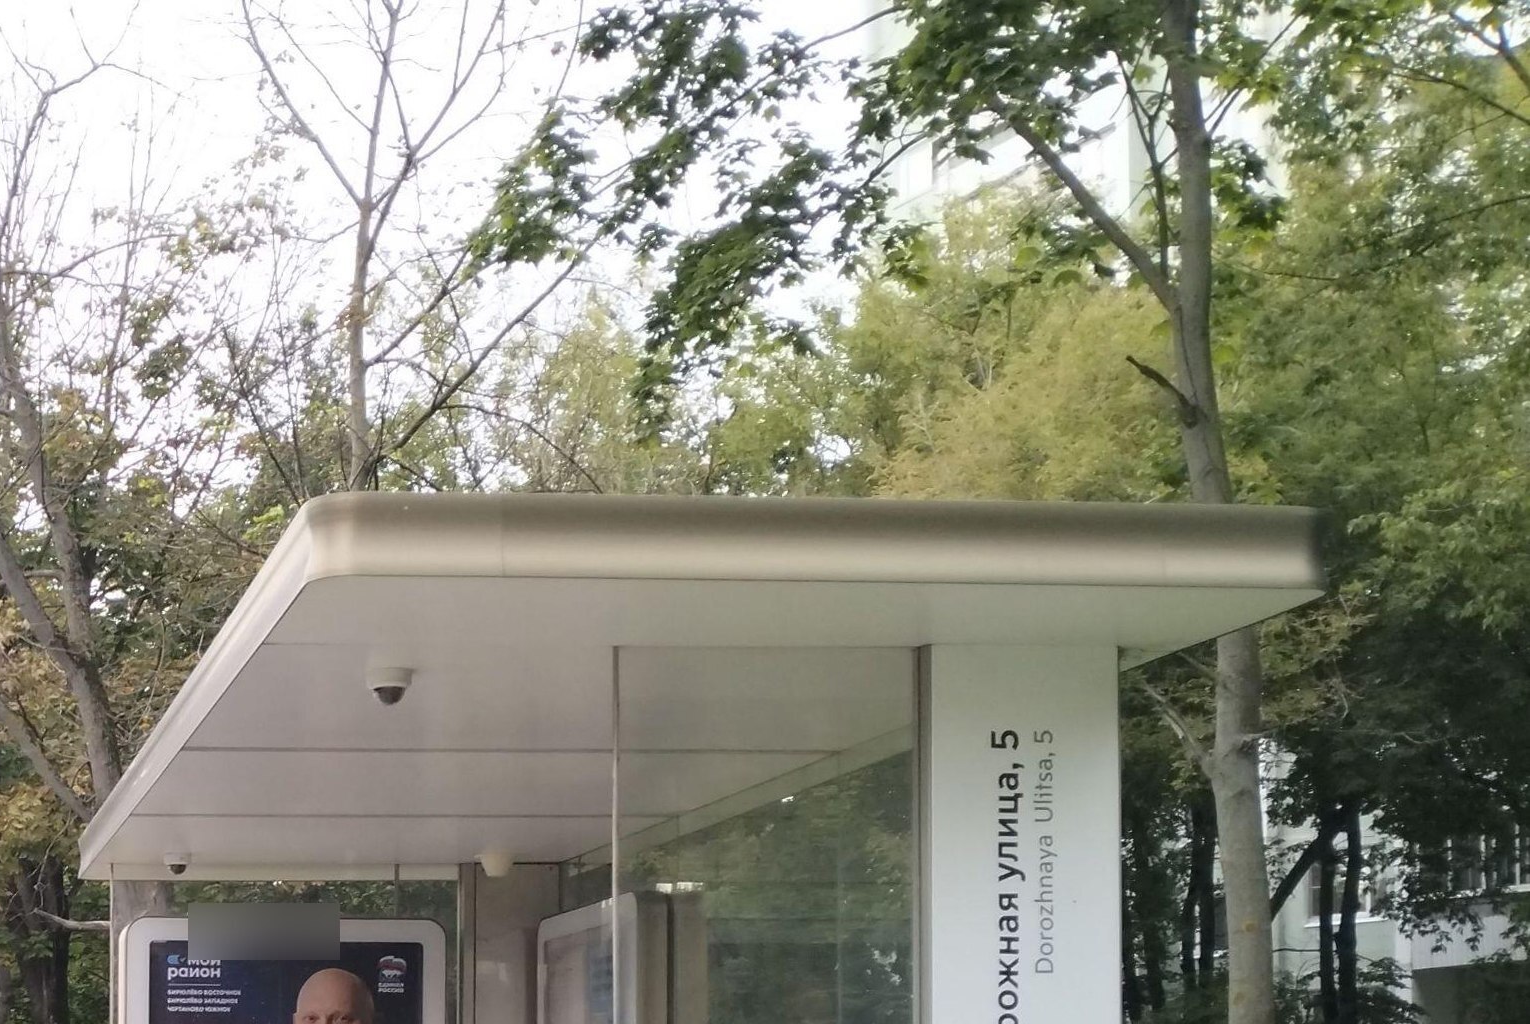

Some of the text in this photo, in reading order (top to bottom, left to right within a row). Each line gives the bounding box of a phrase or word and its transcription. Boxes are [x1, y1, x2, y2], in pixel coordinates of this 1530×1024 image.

[991, 729, 1019, 750] 5
[998, 763, 1025, 882] улица,
[1034, 729, 1058, 974] Dorozhnaya Ulitsa, 5
